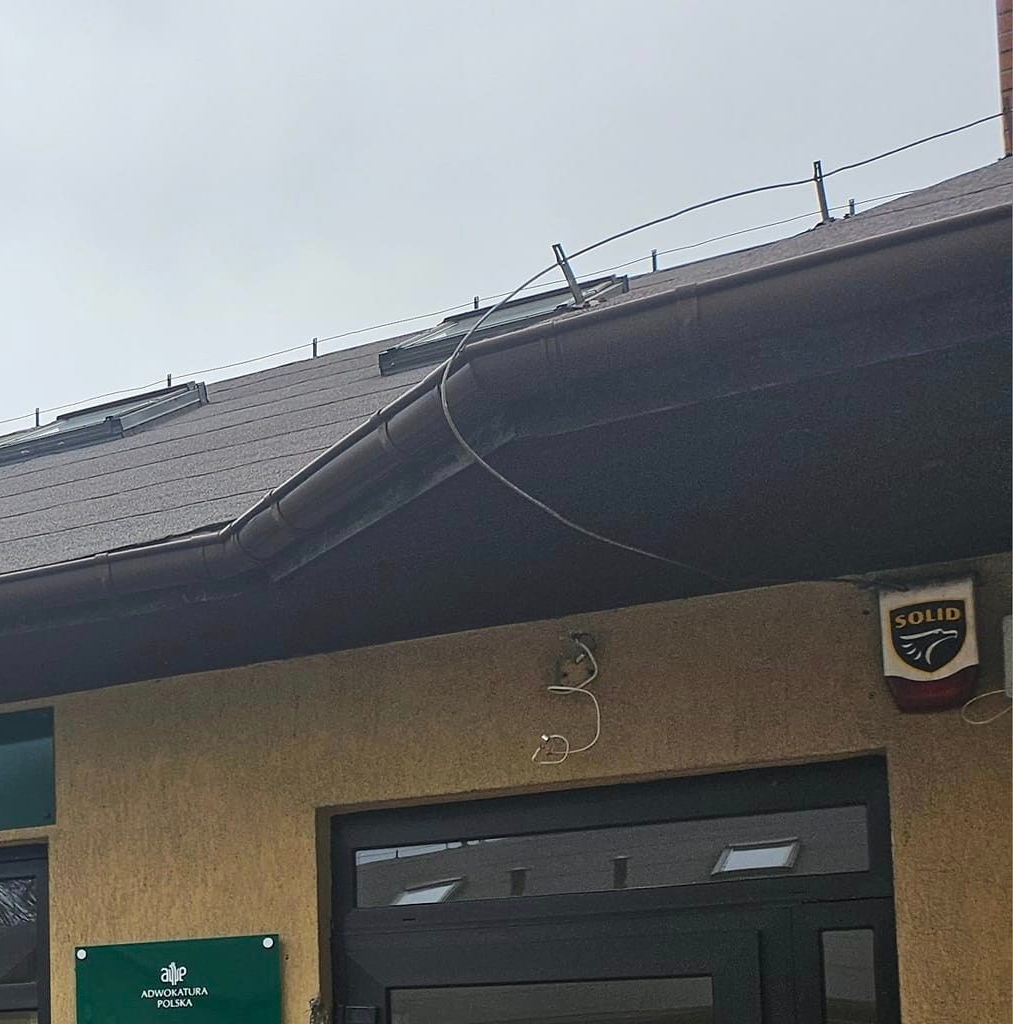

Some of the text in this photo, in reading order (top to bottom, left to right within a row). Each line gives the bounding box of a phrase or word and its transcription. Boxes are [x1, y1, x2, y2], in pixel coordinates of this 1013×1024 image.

[895, 607, 961, 628] SOLID
[141, 987, 208, 998] ADWOKATURA
[157, 999, 193, 1008] POLSKA
